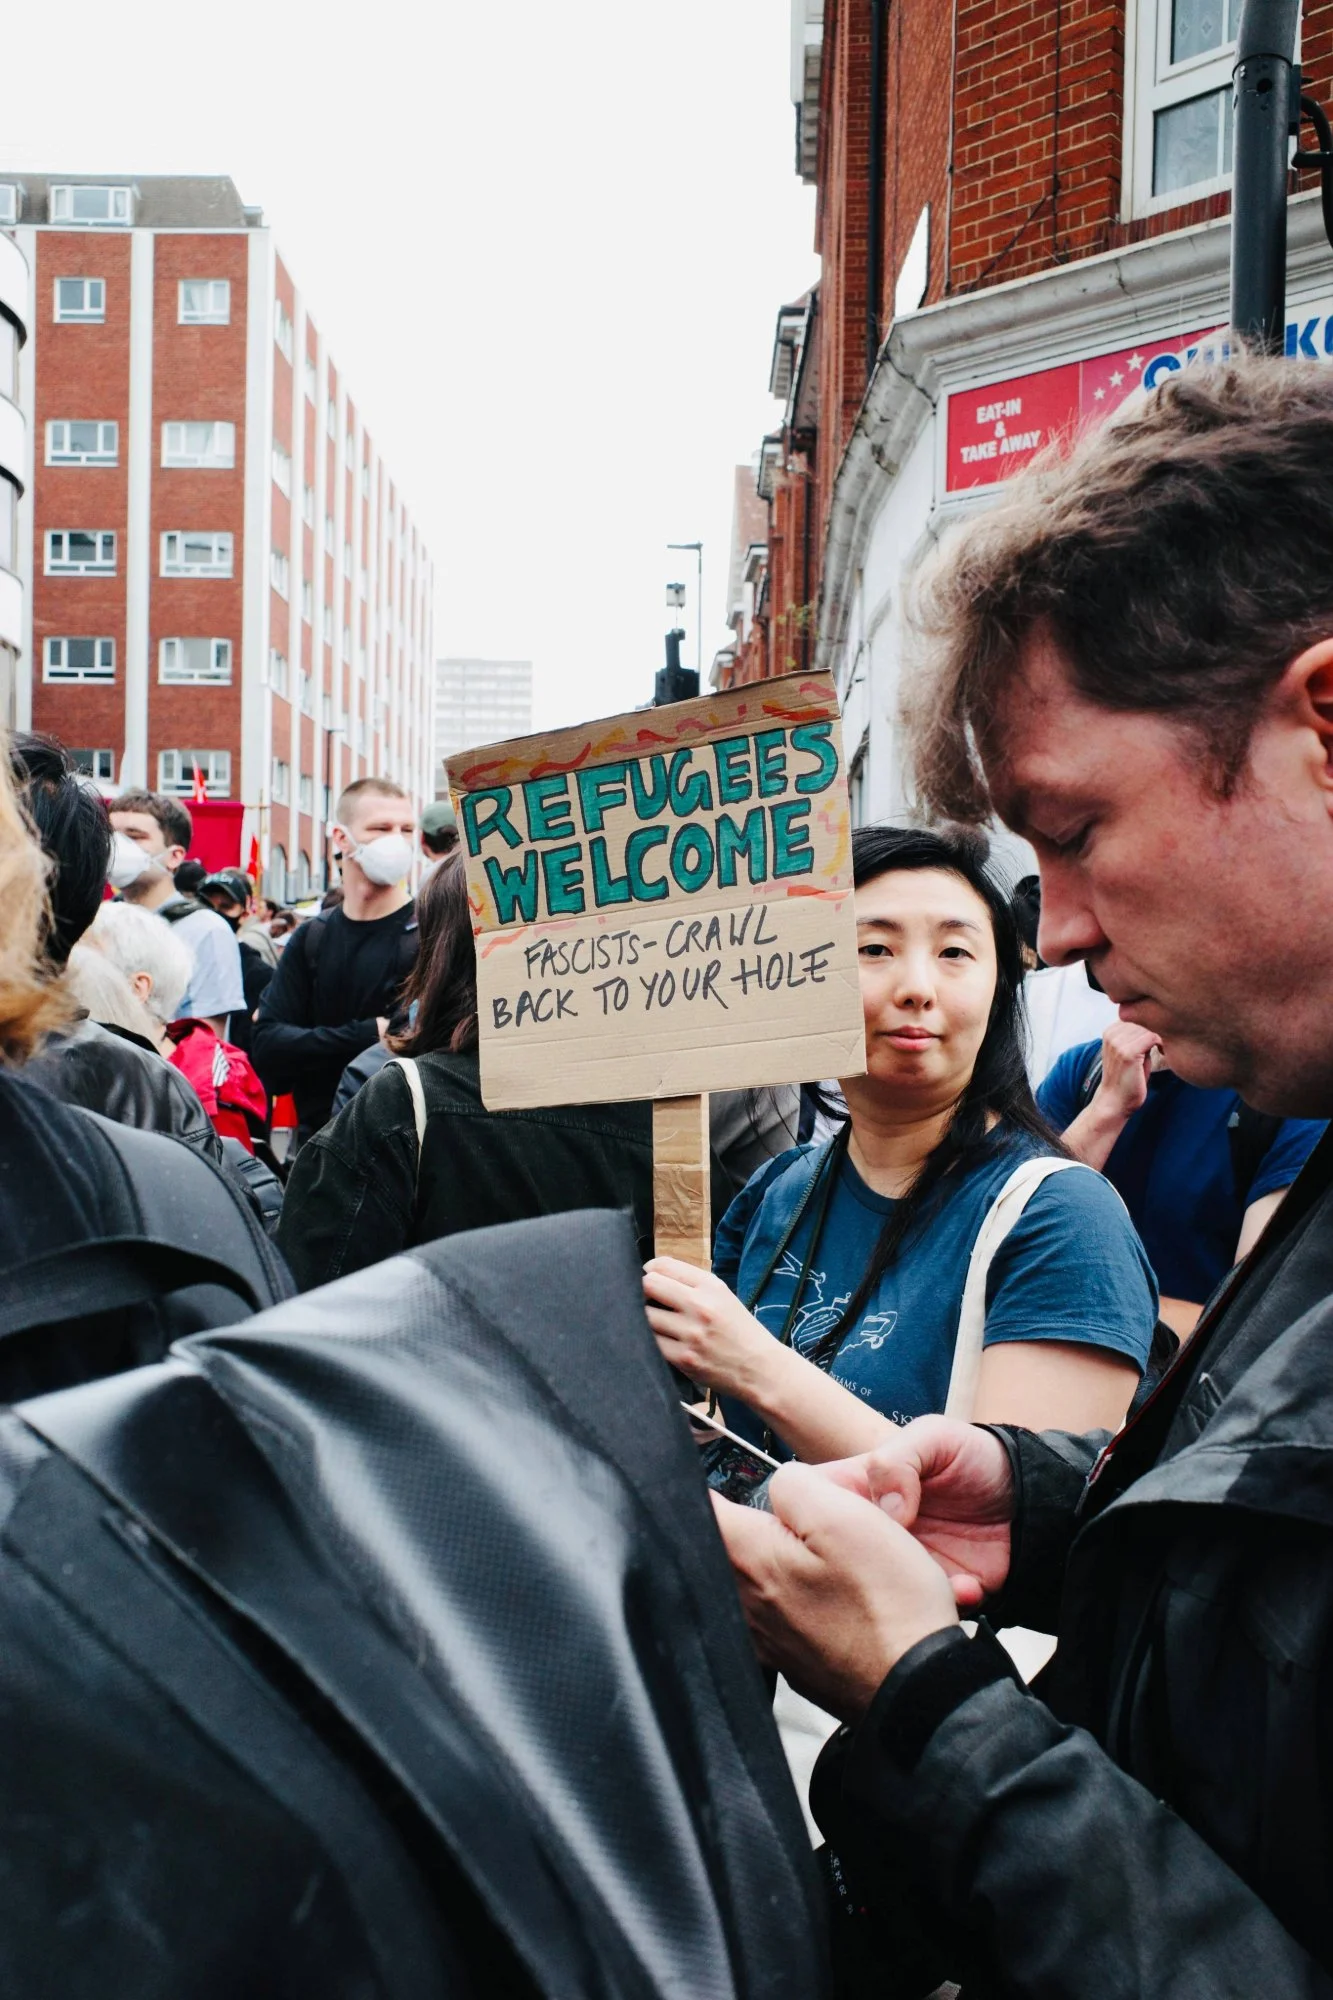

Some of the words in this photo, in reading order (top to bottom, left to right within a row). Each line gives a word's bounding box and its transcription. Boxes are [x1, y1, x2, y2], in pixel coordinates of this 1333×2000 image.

[976, 397, 1022, 424] EAT-IN
[960, 440, 998, 464] TAKE
[999, 429, 1041, 455] AWAY
[994, 420, 1006, 438] &
[460, 721, 839, 857] REFUGEES
[483, 798, 815, 925] WELCOME
[492, 988, 579, 1030] BACK
[593, 976, 629, 1015] TO
[639, 959, 729, 1010] YOUR
[730, 942, 836, 996] HOLE
[860, 1386, 873, 1397] OF
